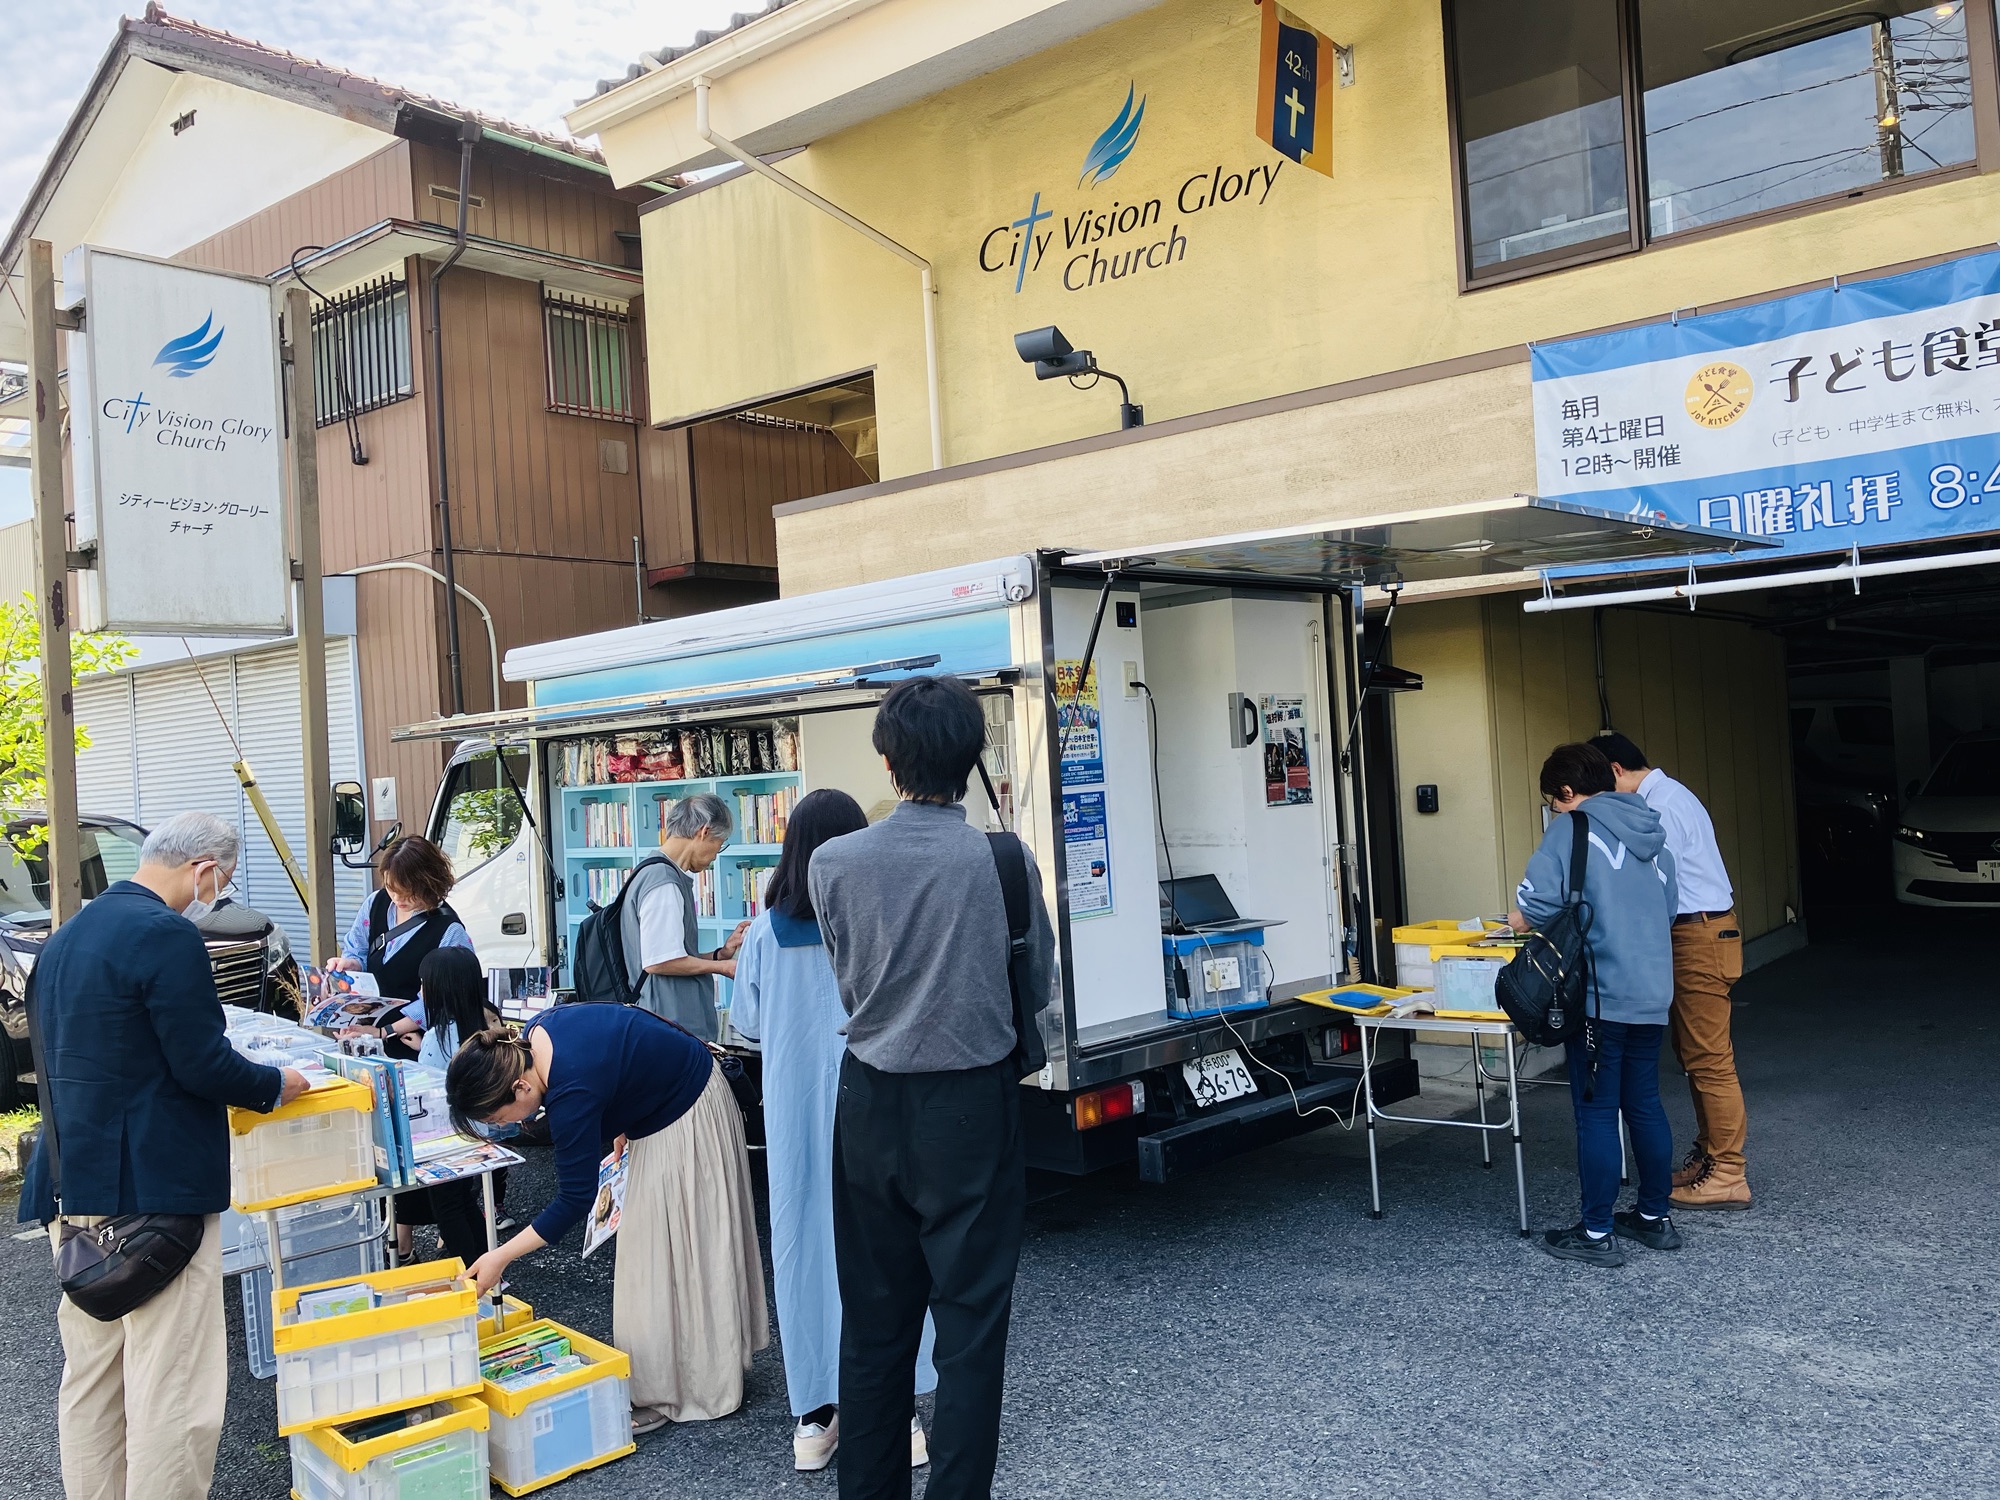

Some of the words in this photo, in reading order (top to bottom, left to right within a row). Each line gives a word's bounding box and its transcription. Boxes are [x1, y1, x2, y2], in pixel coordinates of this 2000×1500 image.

[979, 191, 1054, 294] City
[1063, 199, 1161, 250] Vision
[1177, 160, 1284, 214] Glory
[1063, 224, 1187, 292] Church
[103, 391, 151, 434] City
[157, 409, 213, 431] Vision
[221, 418, 272, 443] Glory
[1561, 395, 1600, 421] 毎月
[1691, 410, 1706, 423] JOY
[1708, 401, 1745, 426] KITCHEN
[156, 429, 226, 452] Church
[1561, 415, 1665, 449] 第4土曜日
[1698, 470, 1902, 536] 日曜礼拝
[169, 520, 213, 536] チャーチ
[1211, 1054, 1229, 1069] 800
